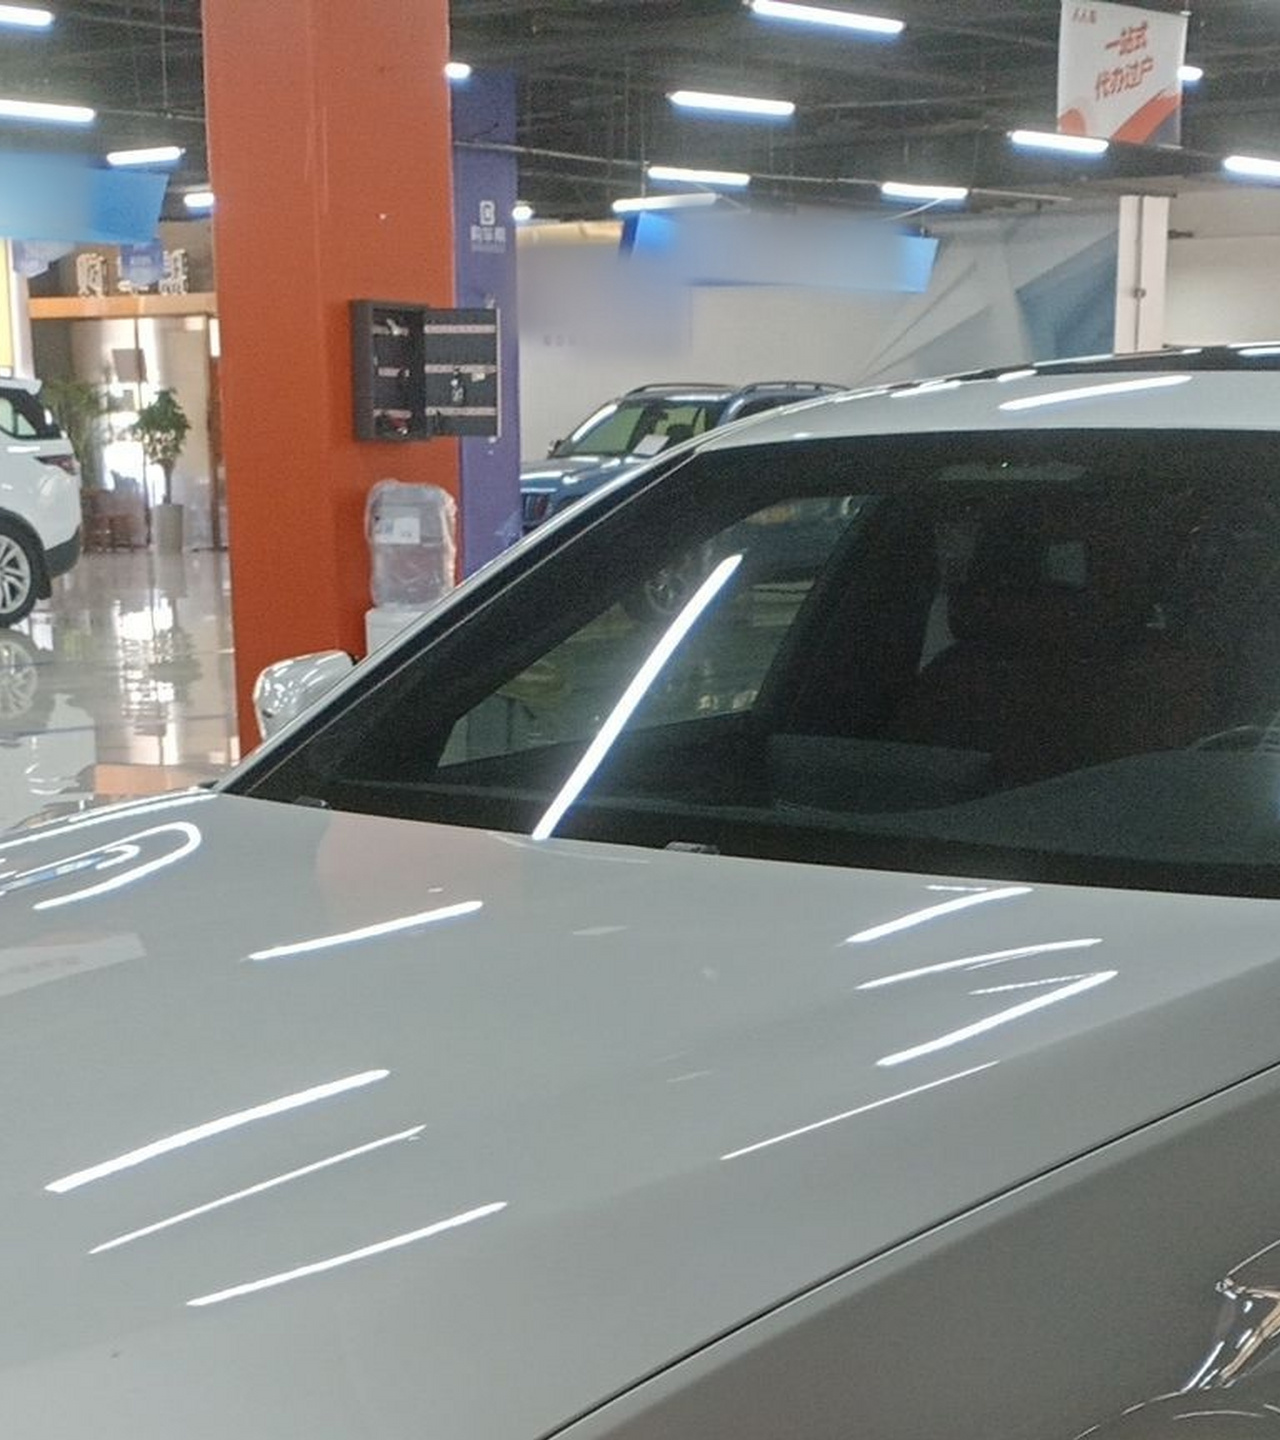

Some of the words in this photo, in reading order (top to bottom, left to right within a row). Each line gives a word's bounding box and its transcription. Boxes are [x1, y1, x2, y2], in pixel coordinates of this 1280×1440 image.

[1104, 20, 1148, 56] 一站式
[1094, 54, 1154, 101] 代办过户
